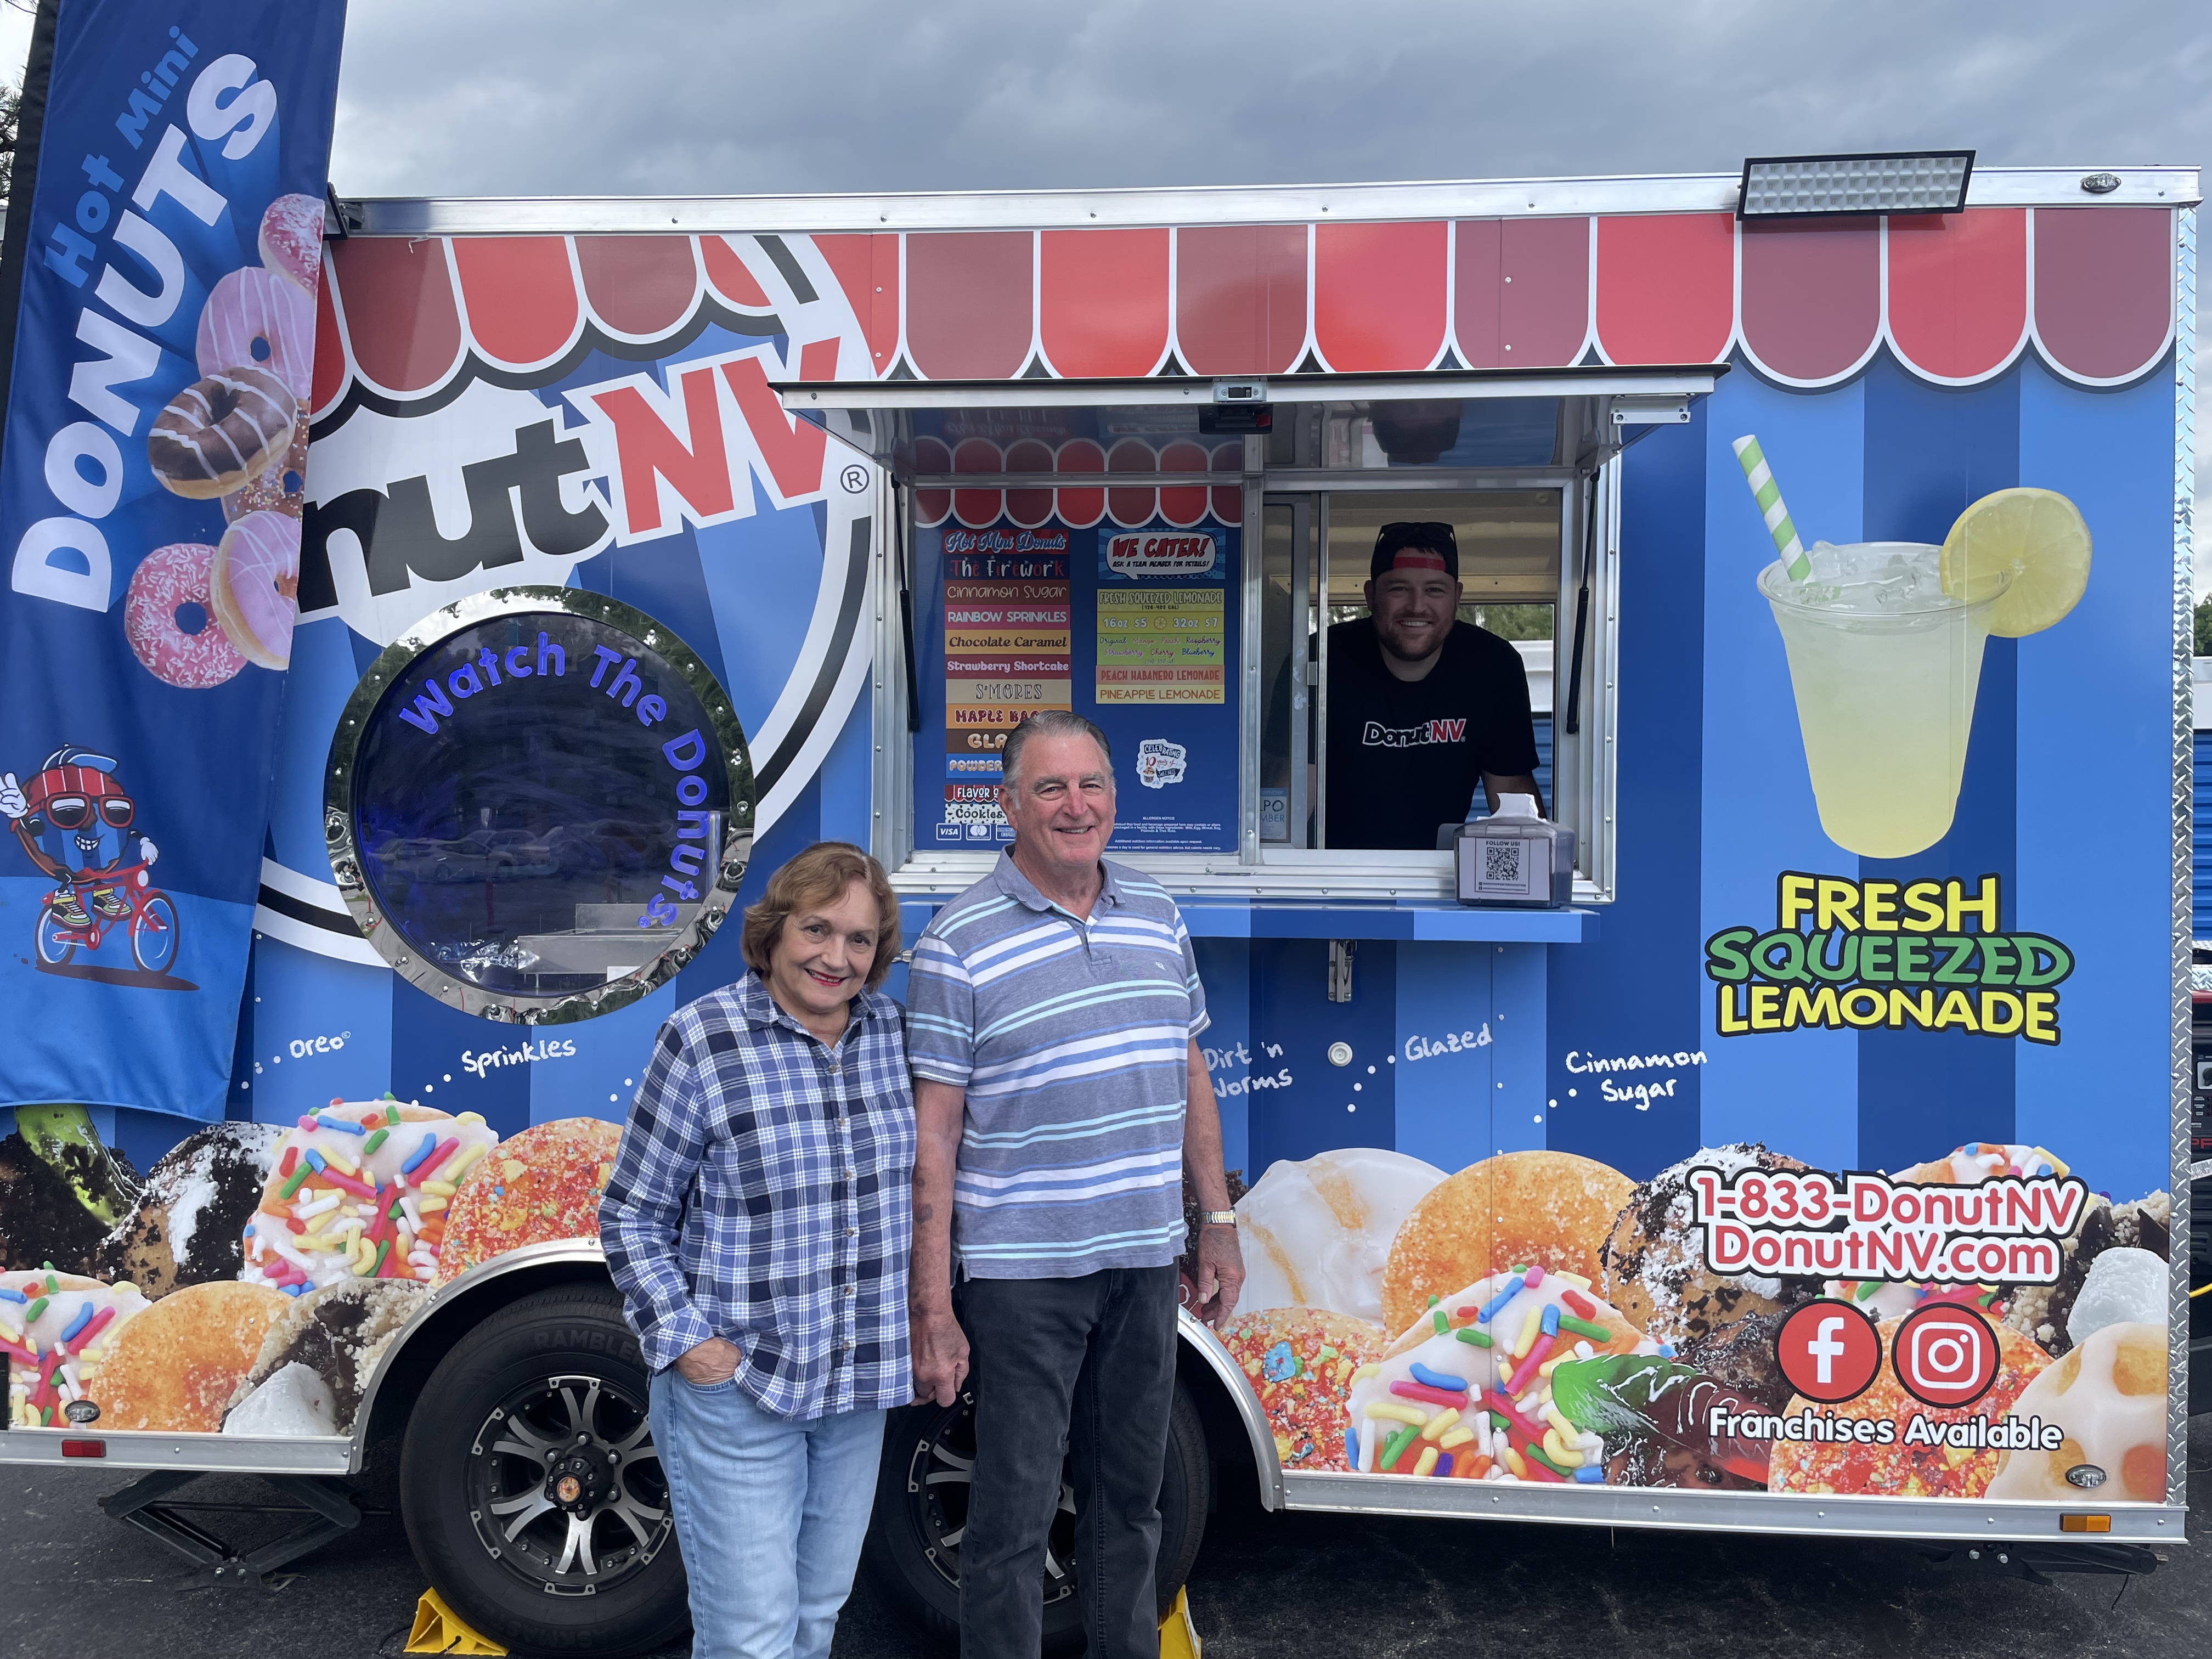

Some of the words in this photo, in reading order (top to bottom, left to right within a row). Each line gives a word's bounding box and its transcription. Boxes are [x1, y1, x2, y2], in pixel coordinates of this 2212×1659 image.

[44, 154, 124, 288] Hot
[115, 26, 199, 149] Mini
[12, 54, 277, 613] DONUTS
[297, 336, 841, 613] nutNV
[945, 531, 977, 552] Hot
[977, 531, 1014, 553] Mini
[1016, 531, 1067, 552] Donuts
[1113, 538, 1139, 558] WE
[1144, 538, 1210, 558] CATER!
[950, 559, 980, 577] The
[987, 559, 1064, 577] Firework
[1023, 585, 1067, 599] Sugar
[1099, 591, 1126, 604] FRESH
[1128, 591, 1172, 604] SQUEEZED
[1173, 591, 1222, 604] LEMONADE
[948, 612, 1003, 622] RAINBOW
[1007, 611, 1067, 622] SPRINKLES
[1134, 617, 1147, 628] $5
[949, 636, 1012, 647] Chocolate
[1014, 636, 1068, 647] Caramel
[1100, 636, 1127, 646] Original
[1132, 636, 1156, 647] Mango
[1161, 636, 1181, 645] Peach
[1186, 636, 1221, 647] Raspberry
[1104, 648, 1144, 658] Strawberry
[1150, 648, 1175, 658] Cherry
[1182, 648, 1216, 659] Blueberry
[947, 661, 1011, 673] Strawberry
[1014, 661, 1069, 671] Shortcake
[1101, 670, 1128, 681] PEACH
[1131, 670, 1173, 681] HABANERO
[1177, 670, 1220, 681] LEMONADE
[399, 631, 565, 735] Watch
[589, 645, 667, 726] The
[975, 684, 1042, 699] S'MORES
[1100, 690, 1155, 699] PINEAPPLE
[1159, 690, 1221, 699] LEMONADE
[955, 709, 1005, 723] MAPLE
[967, 733, 1008, 749] GLA
[1144, 744, 1181, 759] CELEBRATING
[949, 760, 1003, 772] POWDER
[1146, 757, 1156, 766] 10
[1780, 873, 1997, 934] FRESH
[1708, 930, 2071, 987] SQUEEZED
[1719, 984, 2057, 1042] LEMONADE
[1405, 1023, 1493, 1062] Glazed
[462, 1039, 577, 1079] Sprinkles
[1201, 1041, 1252, 1071] Dirt
[1566, 1049, 1707, 1074] Cinnamon
[1601, 1078, 1677, 1111] Sugar
[1696, 1176, 2078, 1229] 1-833-DonutNV
[1714, 1224, 2052, 1275] DonutNV.com
[1710, 1407, 1894, 1444] Franchises
[1904, 1414, 2064, 1450] Available
